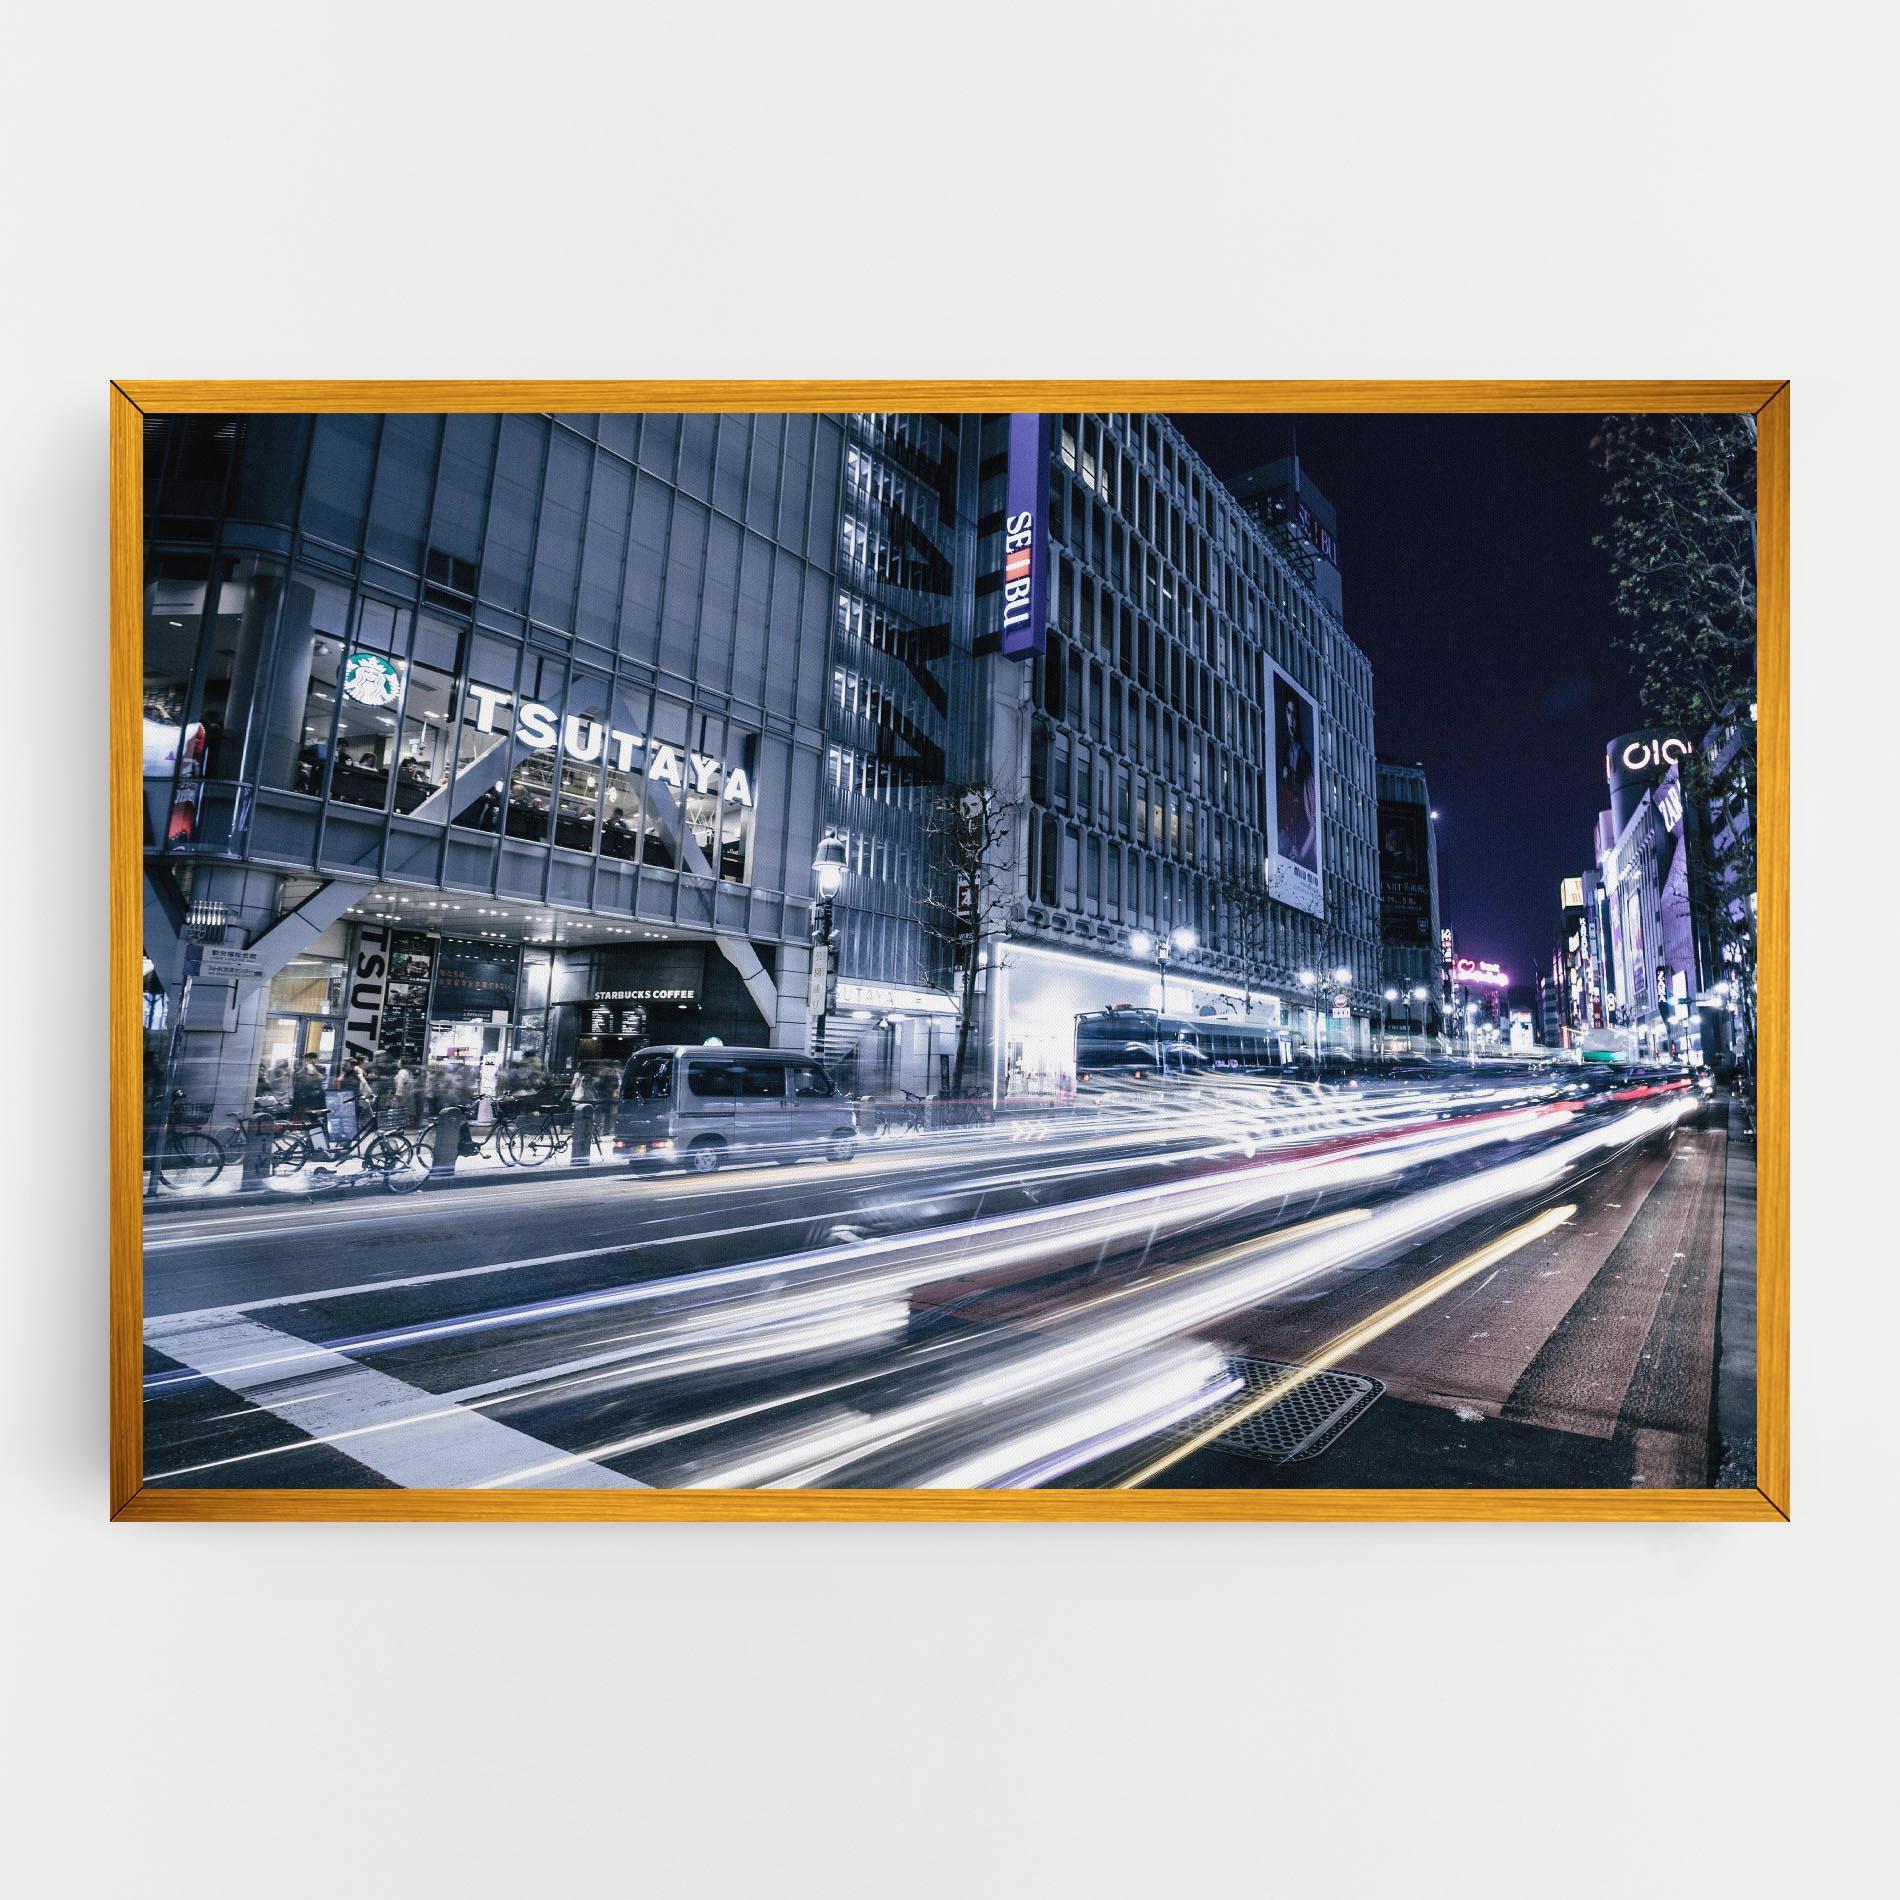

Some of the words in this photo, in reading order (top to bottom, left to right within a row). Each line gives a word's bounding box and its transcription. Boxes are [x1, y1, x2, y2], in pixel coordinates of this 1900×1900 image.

[1004, 511, 1032, 630] SEIBU
[469, 684, 753, 807] TSUTAYA
[594, 990, 652, 1000] STARBUCKS
[652, 989, 695, 999] COFFEE
